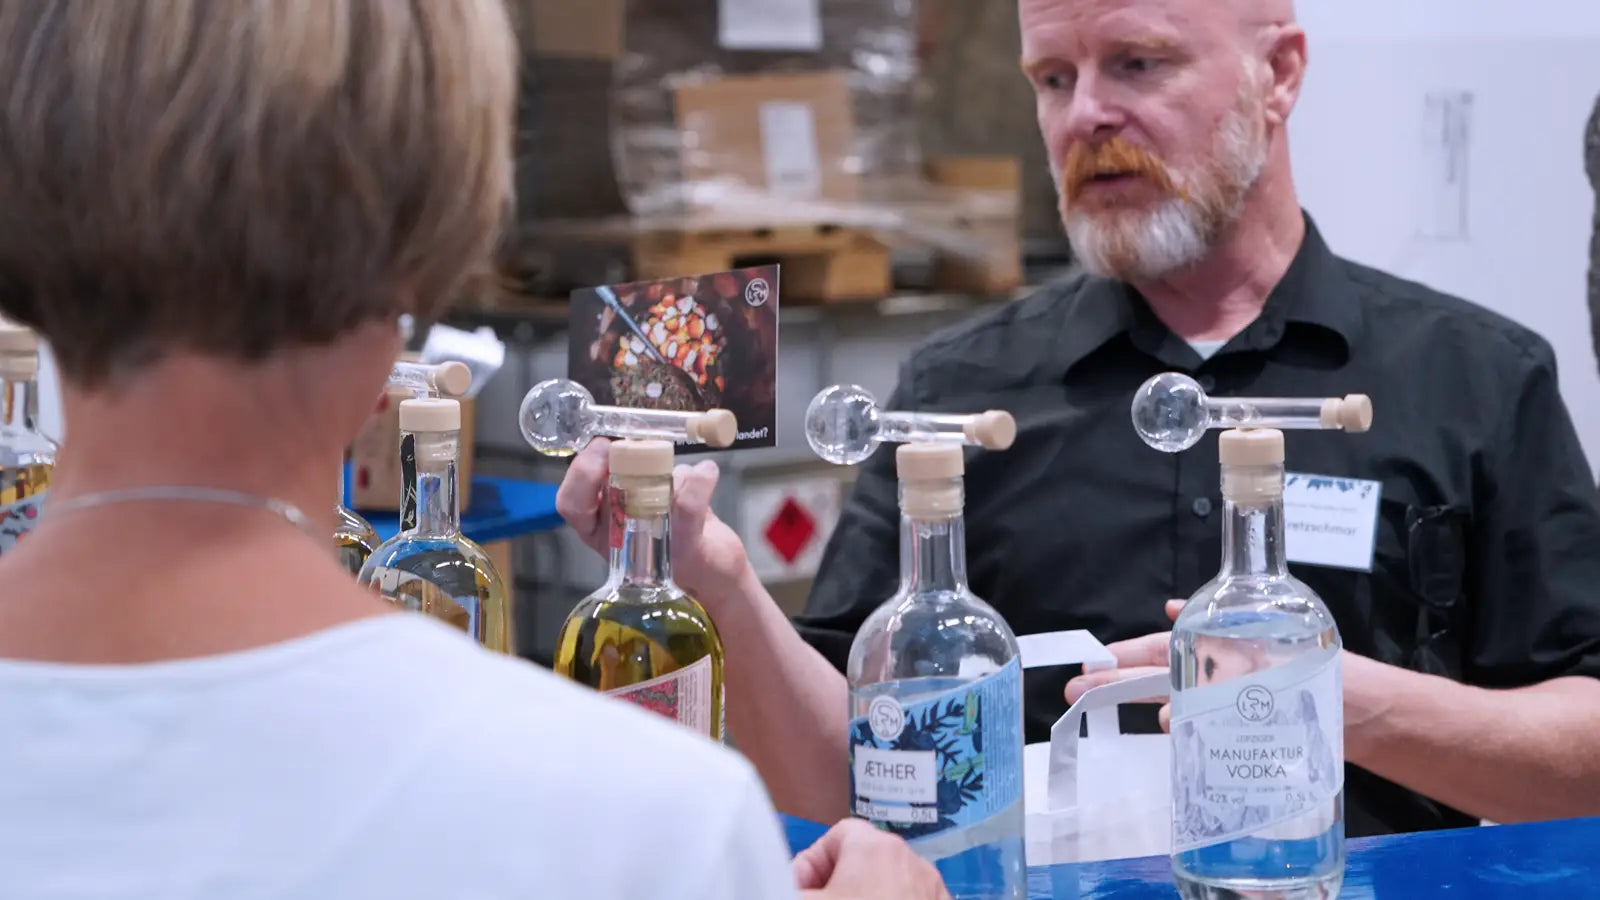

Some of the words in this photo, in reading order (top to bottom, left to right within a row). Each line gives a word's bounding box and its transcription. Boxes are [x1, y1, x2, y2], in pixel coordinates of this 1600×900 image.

[736, 427, 768, 440] landet?
[1210, 746, 1304, 760] MANUFAKTUR
[864, 760, 917, 780] ÆTHER
[1226, 764, 1287, 779] VODKA
